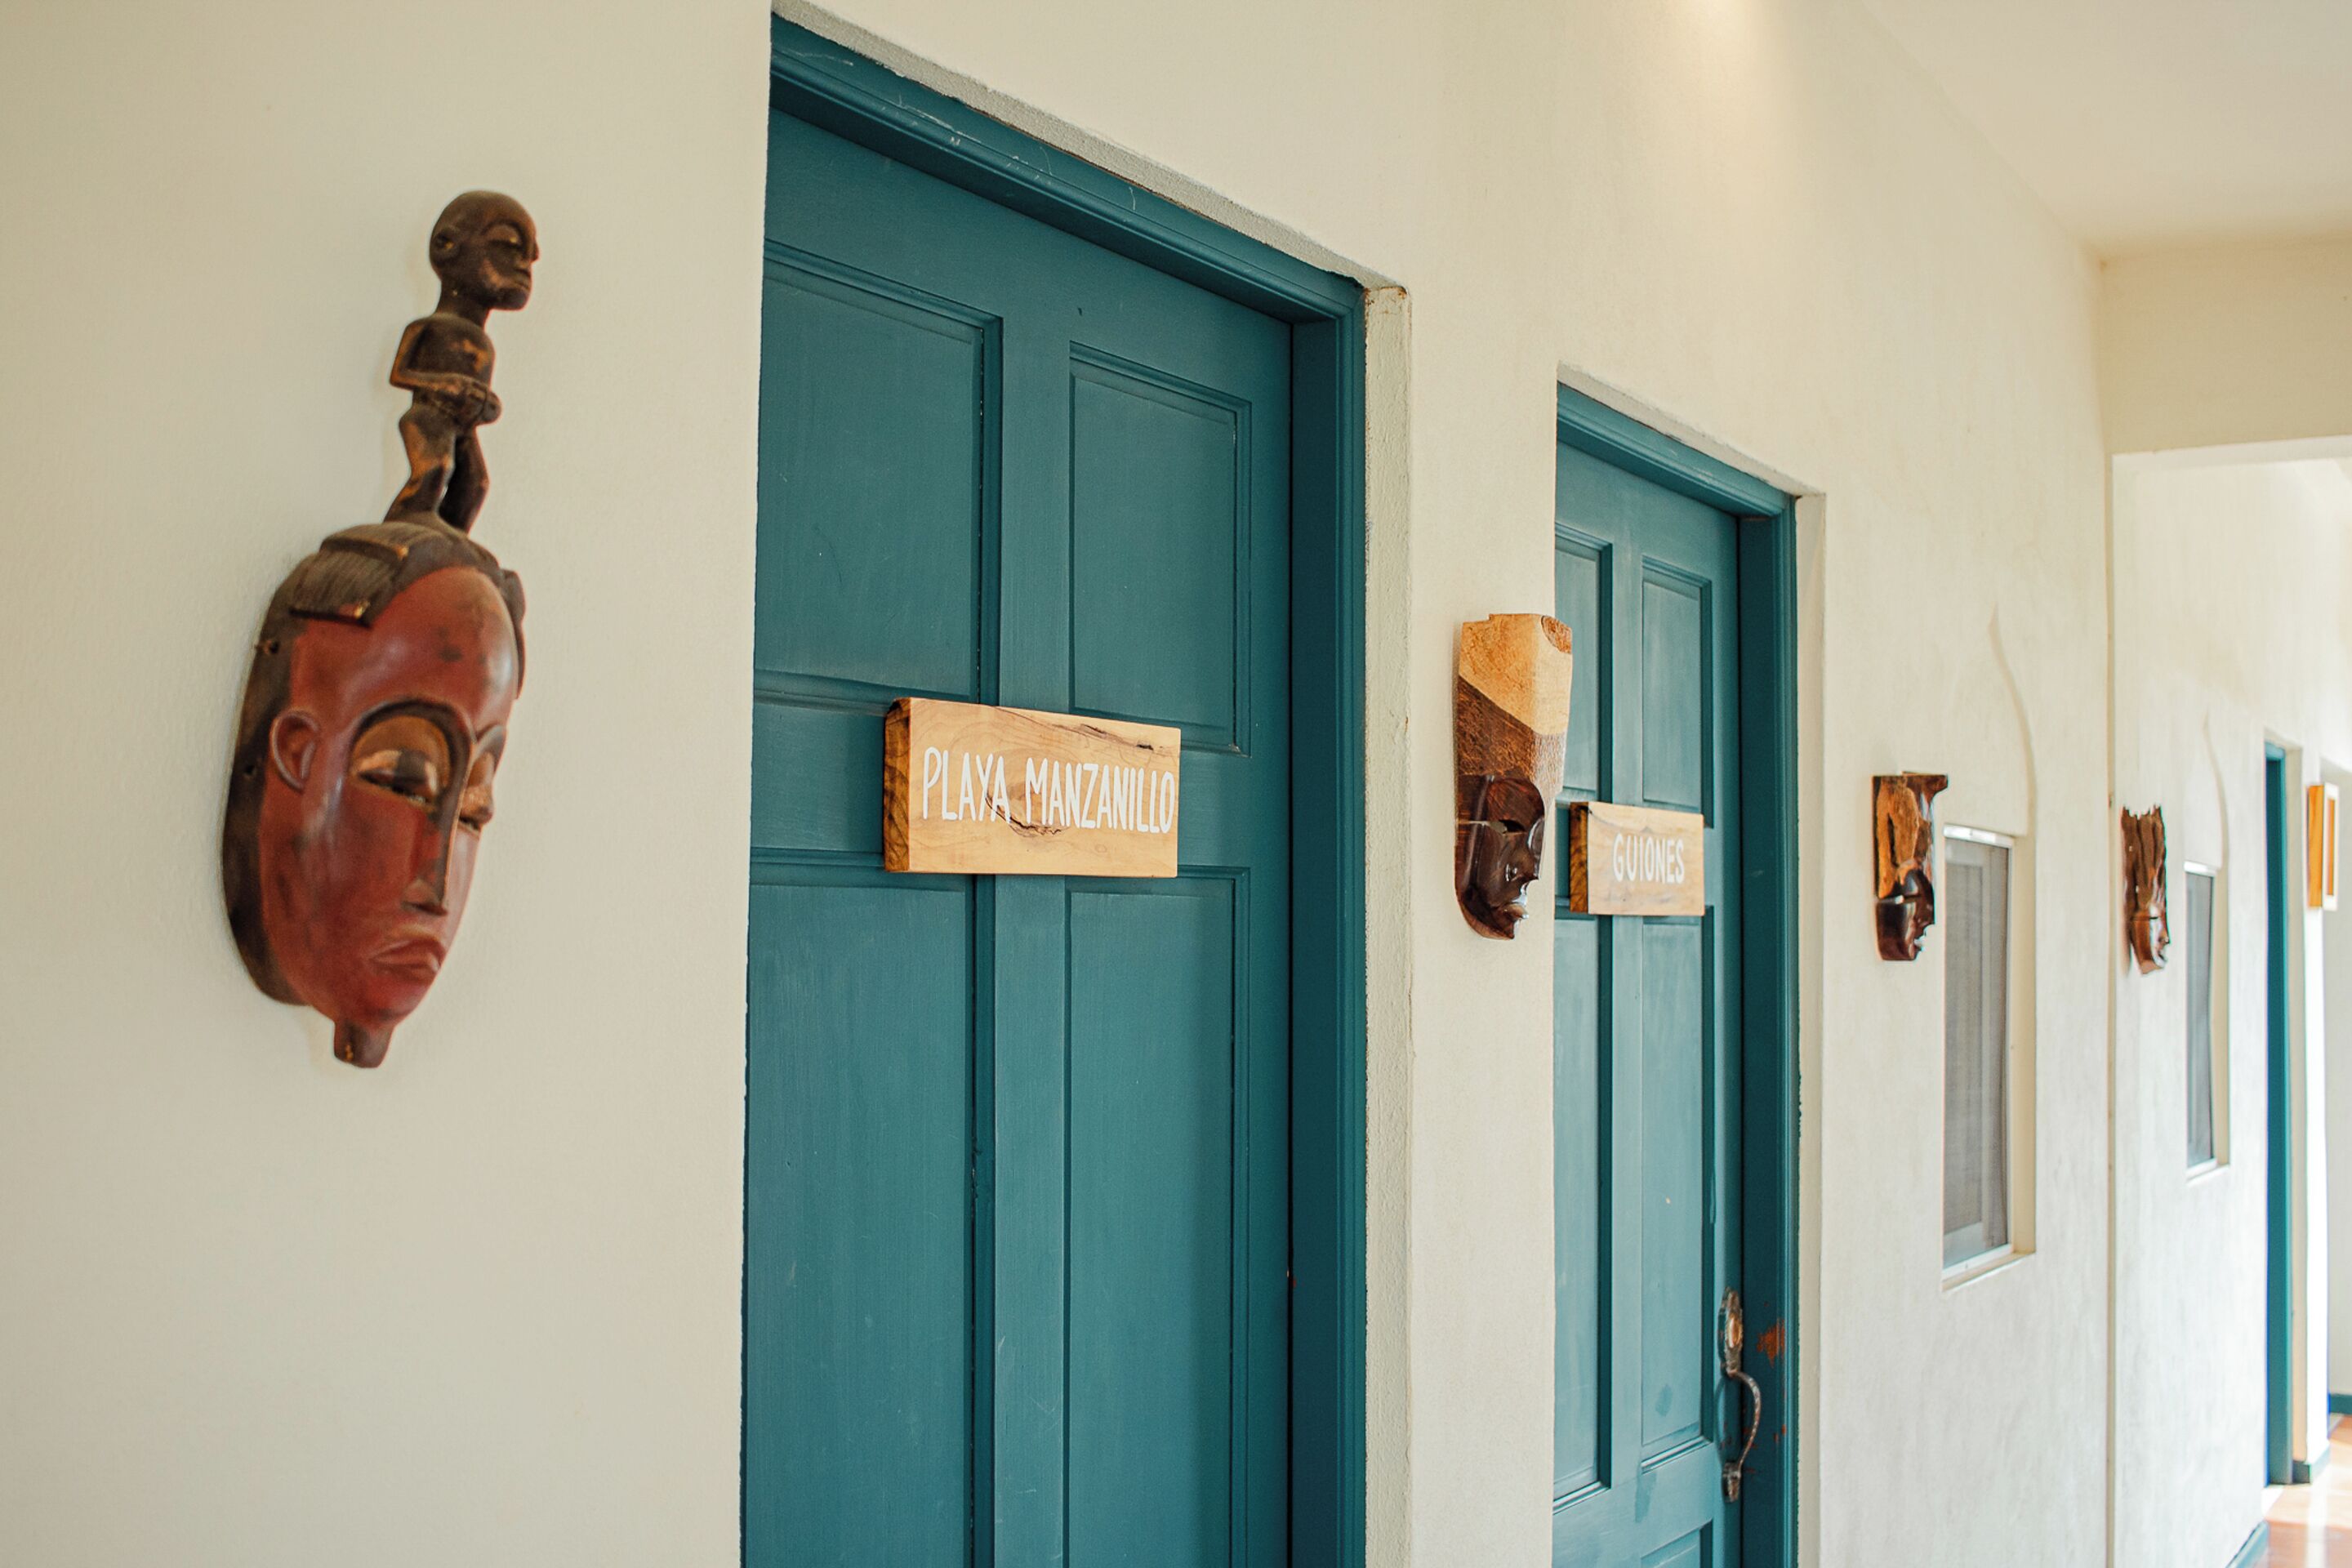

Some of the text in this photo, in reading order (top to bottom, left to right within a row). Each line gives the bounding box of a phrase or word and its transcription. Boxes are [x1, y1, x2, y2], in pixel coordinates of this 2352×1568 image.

[922, 746, 1174, 834] PLAYA MANZANILLO
[1613, 832, 1685, 884] GUIONES
